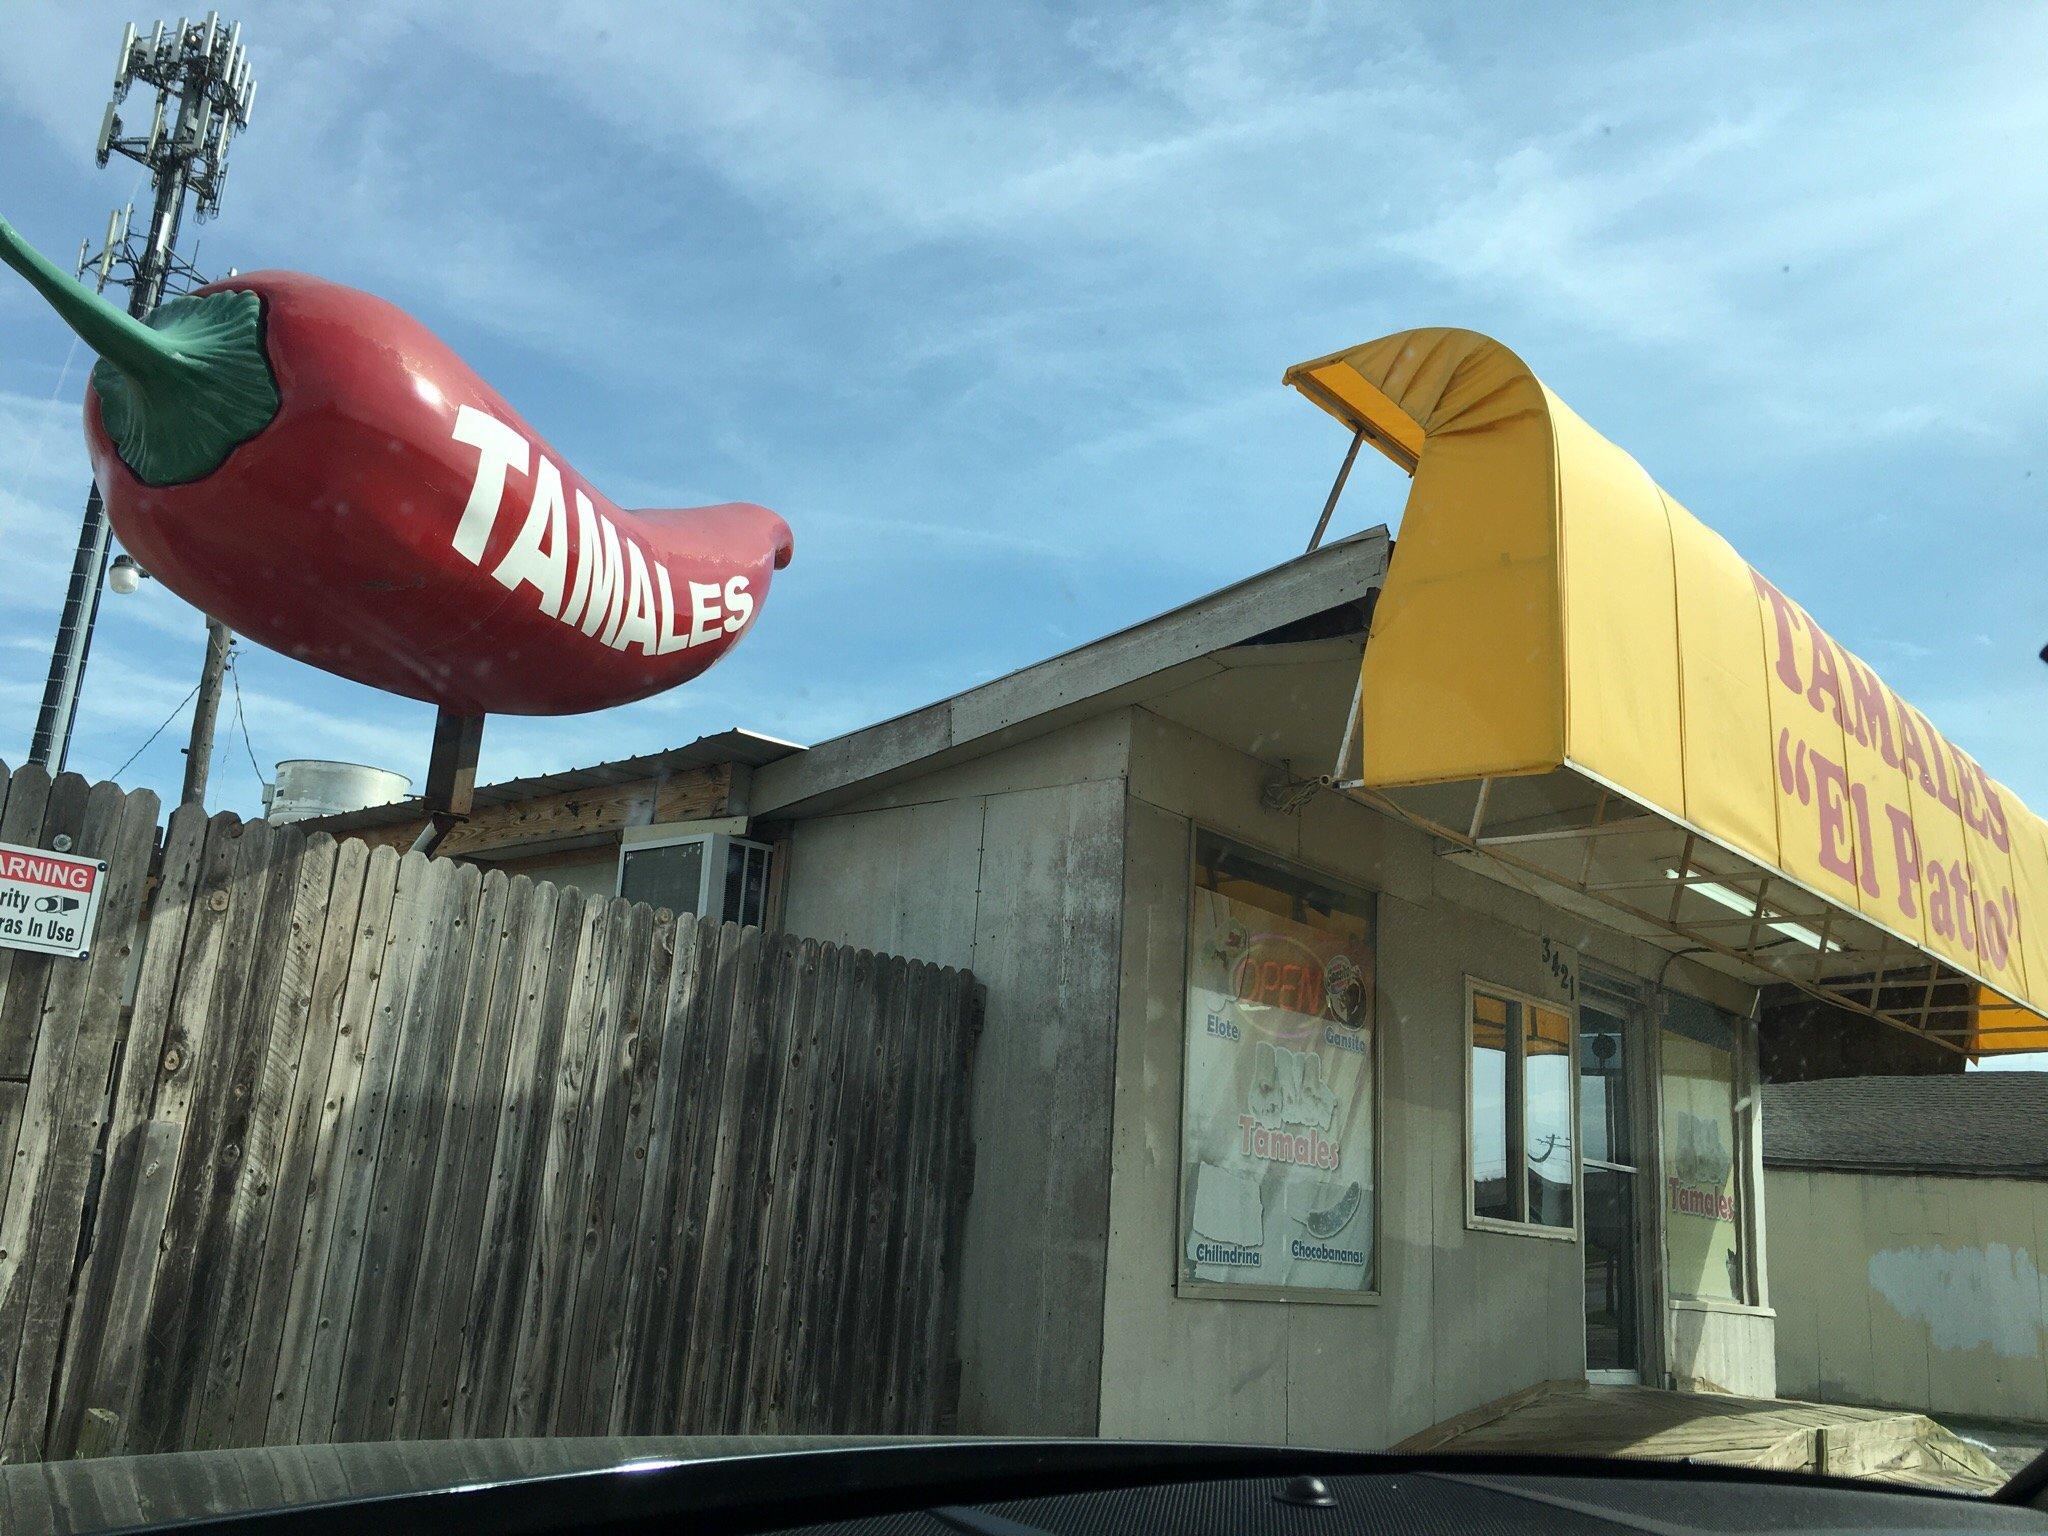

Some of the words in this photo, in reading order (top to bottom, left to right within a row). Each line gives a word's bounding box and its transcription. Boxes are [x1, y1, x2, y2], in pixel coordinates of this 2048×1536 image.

[452, 404, 754, 657] TAMALES
[1748, 564, 2010, 854] TAMALES
[27, 917, 43, 938] In
[46, 920, 75, 942] Use
[1235, 958, 1322, 1015] OPEN
[1542, 937, 1575, 1001] 3421
[1238, 1115, 1339, 1169] Tamales
[1668, 1177, 1735, 1220] Tamales
[1196, 1244, 1261, 1266] Chilindrina
[1292, 1240, 1363, 1266] Chocobananas
